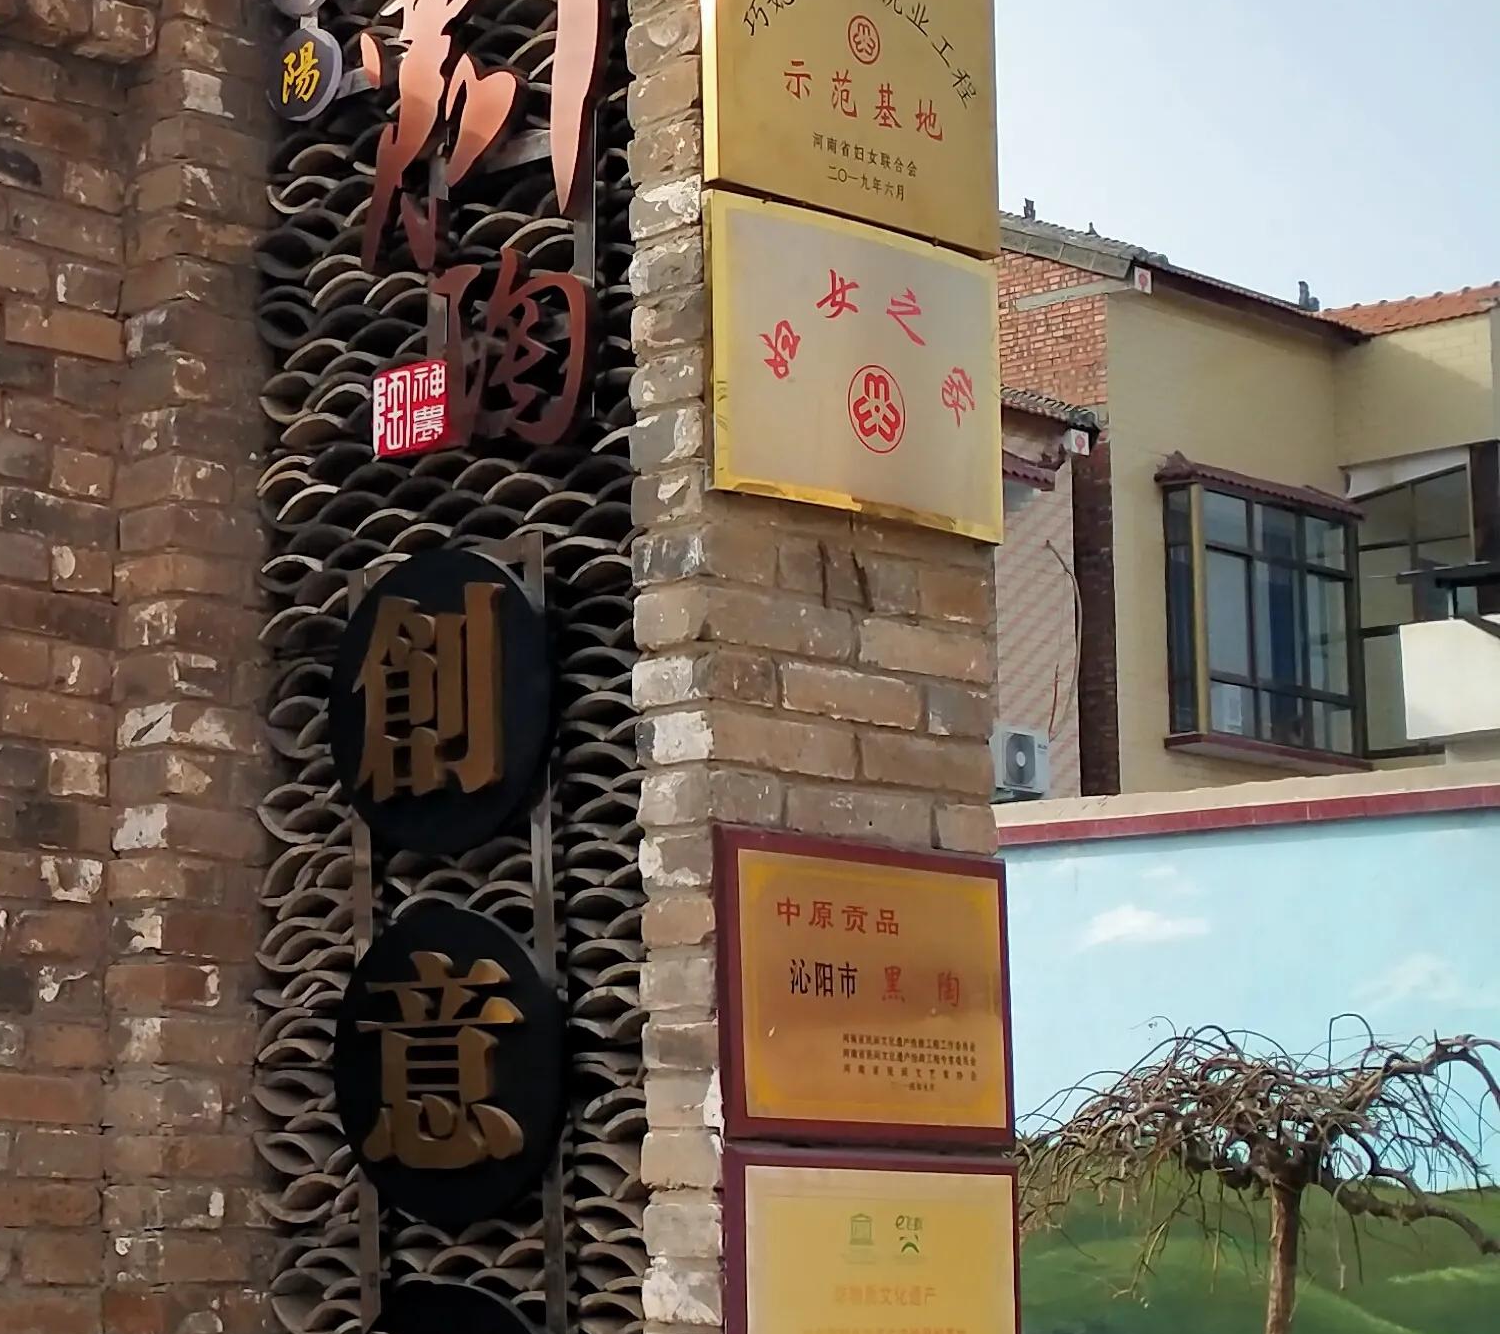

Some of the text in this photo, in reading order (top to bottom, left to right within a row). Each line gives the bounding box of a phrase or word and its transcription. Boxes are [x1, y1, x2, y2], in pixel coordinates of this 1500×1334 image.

[783, 60, 943, 141] 示范基地
[812, 131, 917, 177] 河南省妇女联合会
[759, 269, 977, 428] 妇女之家
[776, 896, 900, 935] 中原贡品
[789, 958, 961, 1007] 沁阳市 黑陶
